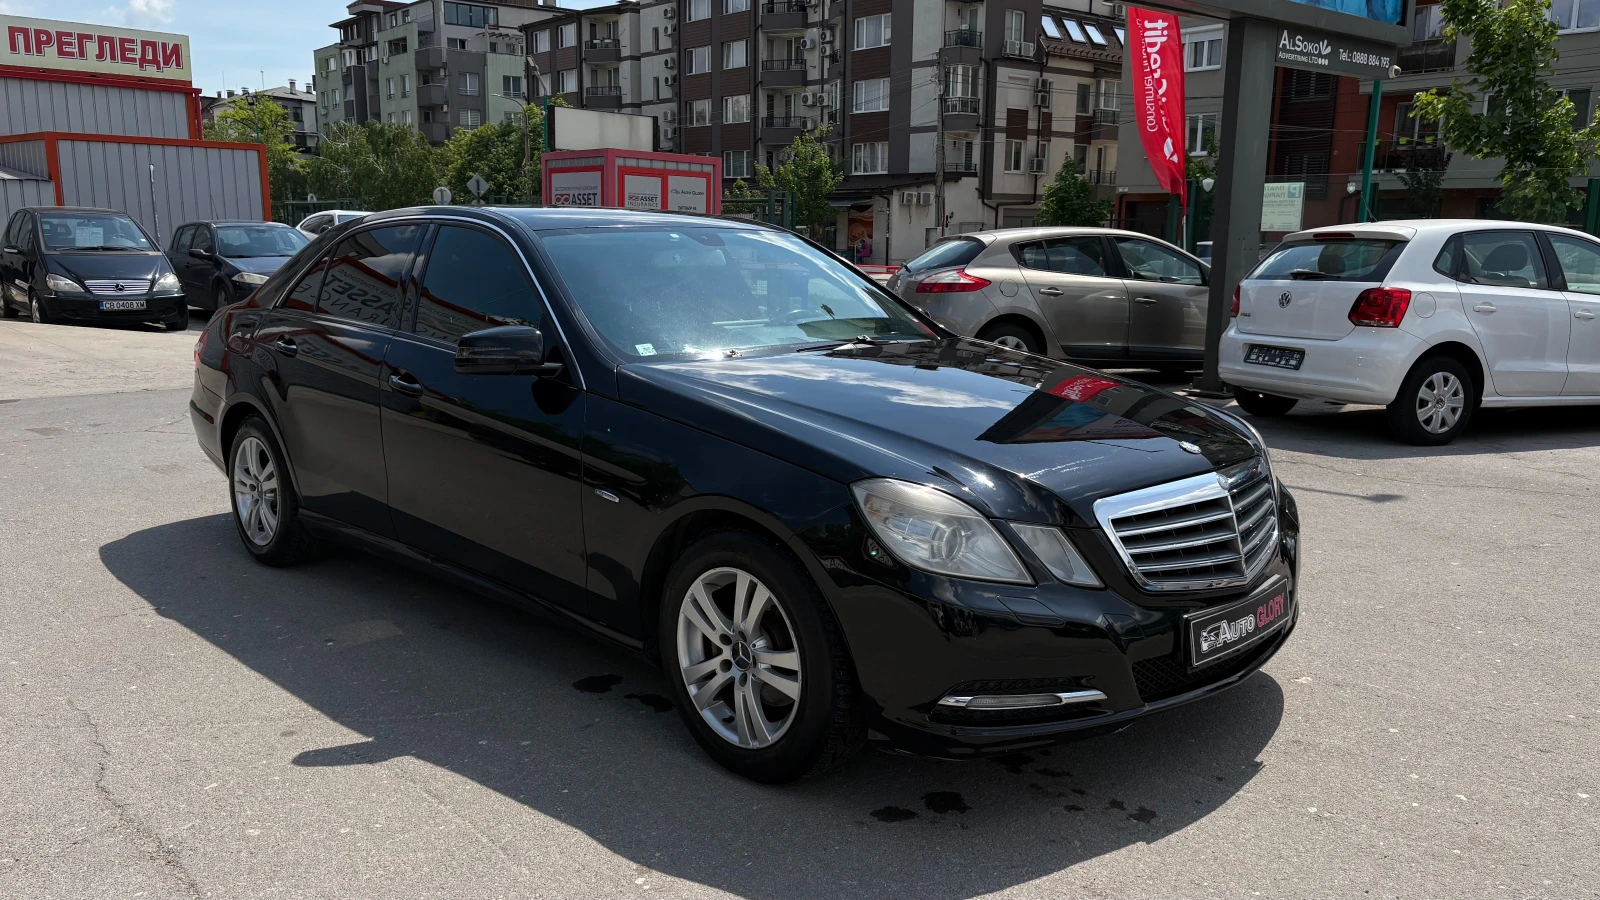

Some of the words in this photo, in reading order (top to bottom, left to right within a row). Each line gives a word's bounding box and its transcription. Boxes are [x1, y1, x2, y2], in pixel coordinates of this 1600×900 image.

[7, 25, 184, 73] ПРЕГЛЕДИ
[1352, 51, 1368, 66] 0888
[1368, 53, 1380, 67] 884
[571, 192, 598, 206] ASSET
[639, 195, 658, 203] ASSET
[1217, 614, 1255, 647] AUTO
[1256, 593, 1285, 627] GLORY
